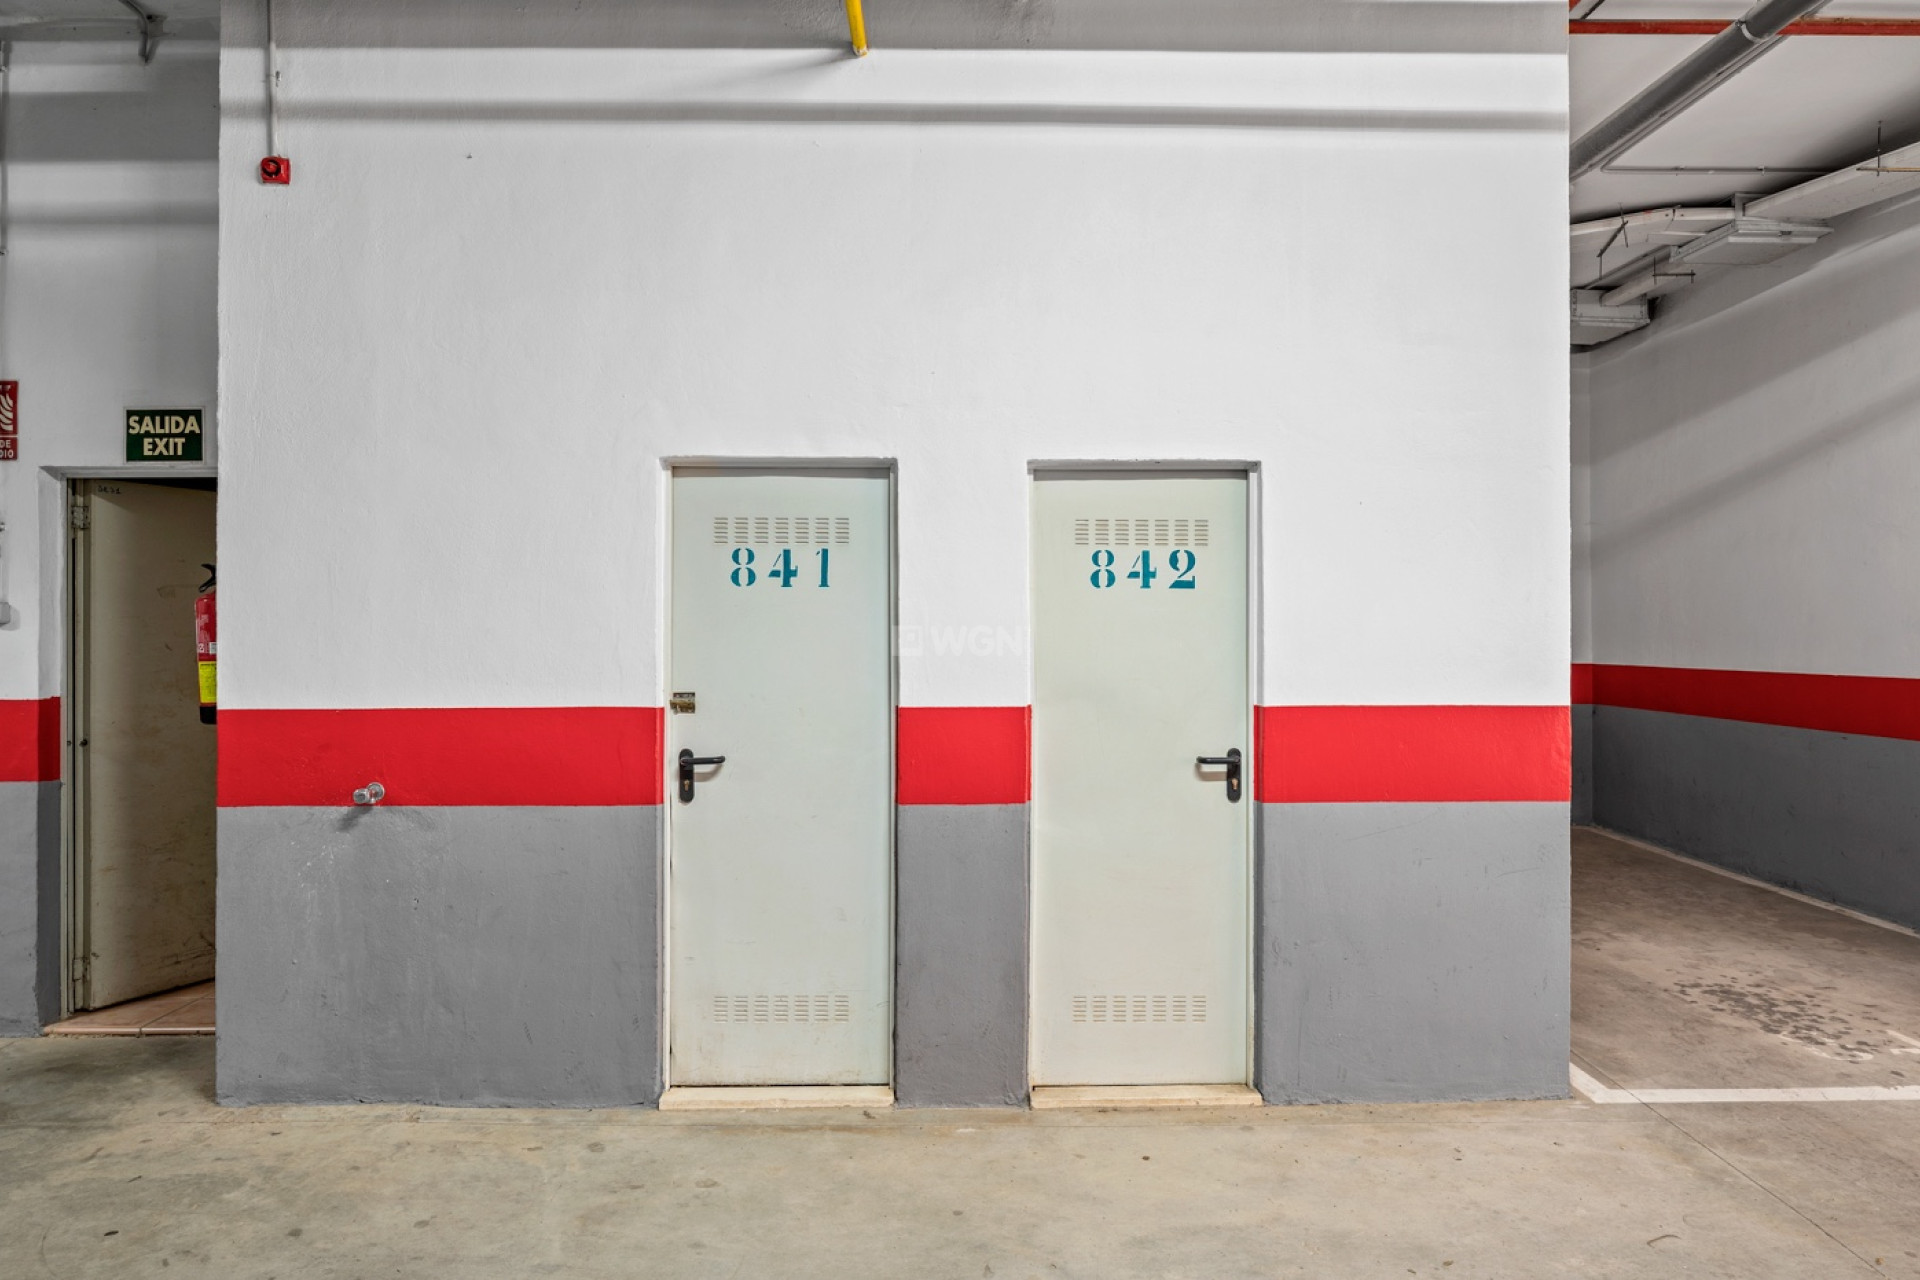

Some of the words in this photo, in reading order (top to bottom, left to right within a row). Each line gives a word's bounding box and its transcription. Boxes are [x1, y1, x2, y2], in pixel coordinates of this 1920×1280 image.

[128, 415, 201, 434] SALIDA
[143, 437, 186, 456] EXIT
[730, 547, 830, 588] 841
[1090, 549, 1196, 589] 842
